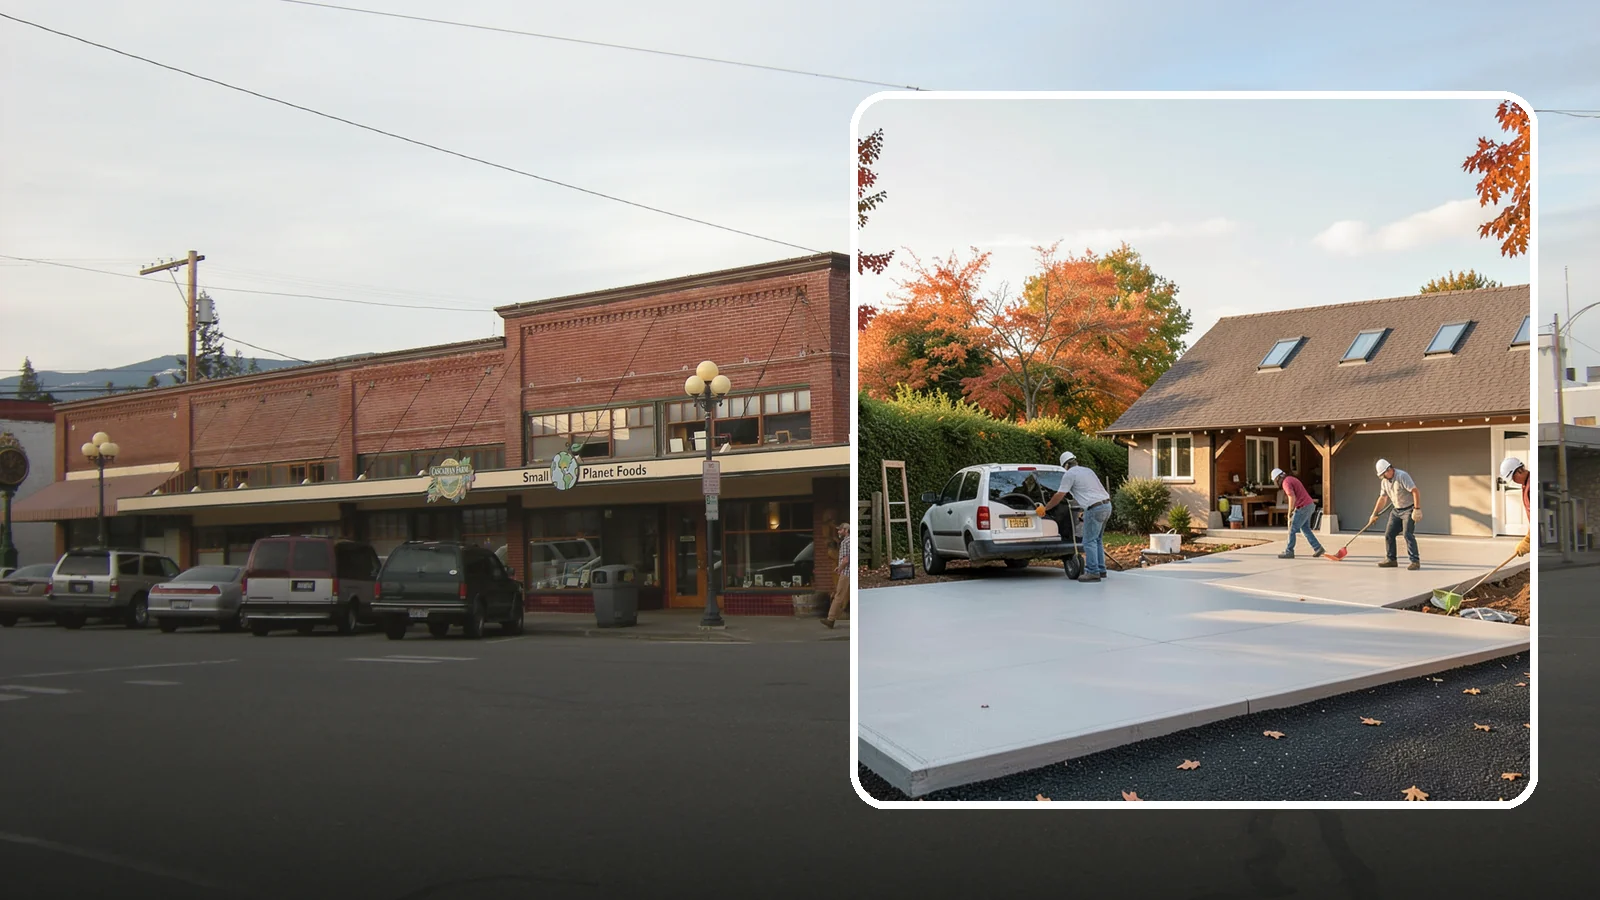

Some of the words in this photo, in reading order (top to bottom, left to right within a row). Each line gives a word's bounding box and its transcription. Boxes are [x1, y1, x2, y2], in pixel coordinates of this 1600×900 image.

[523, 471, 549, 483] Small
[583, 468, 614, 479] Planet
[617, 464, 647, 476] Foods
